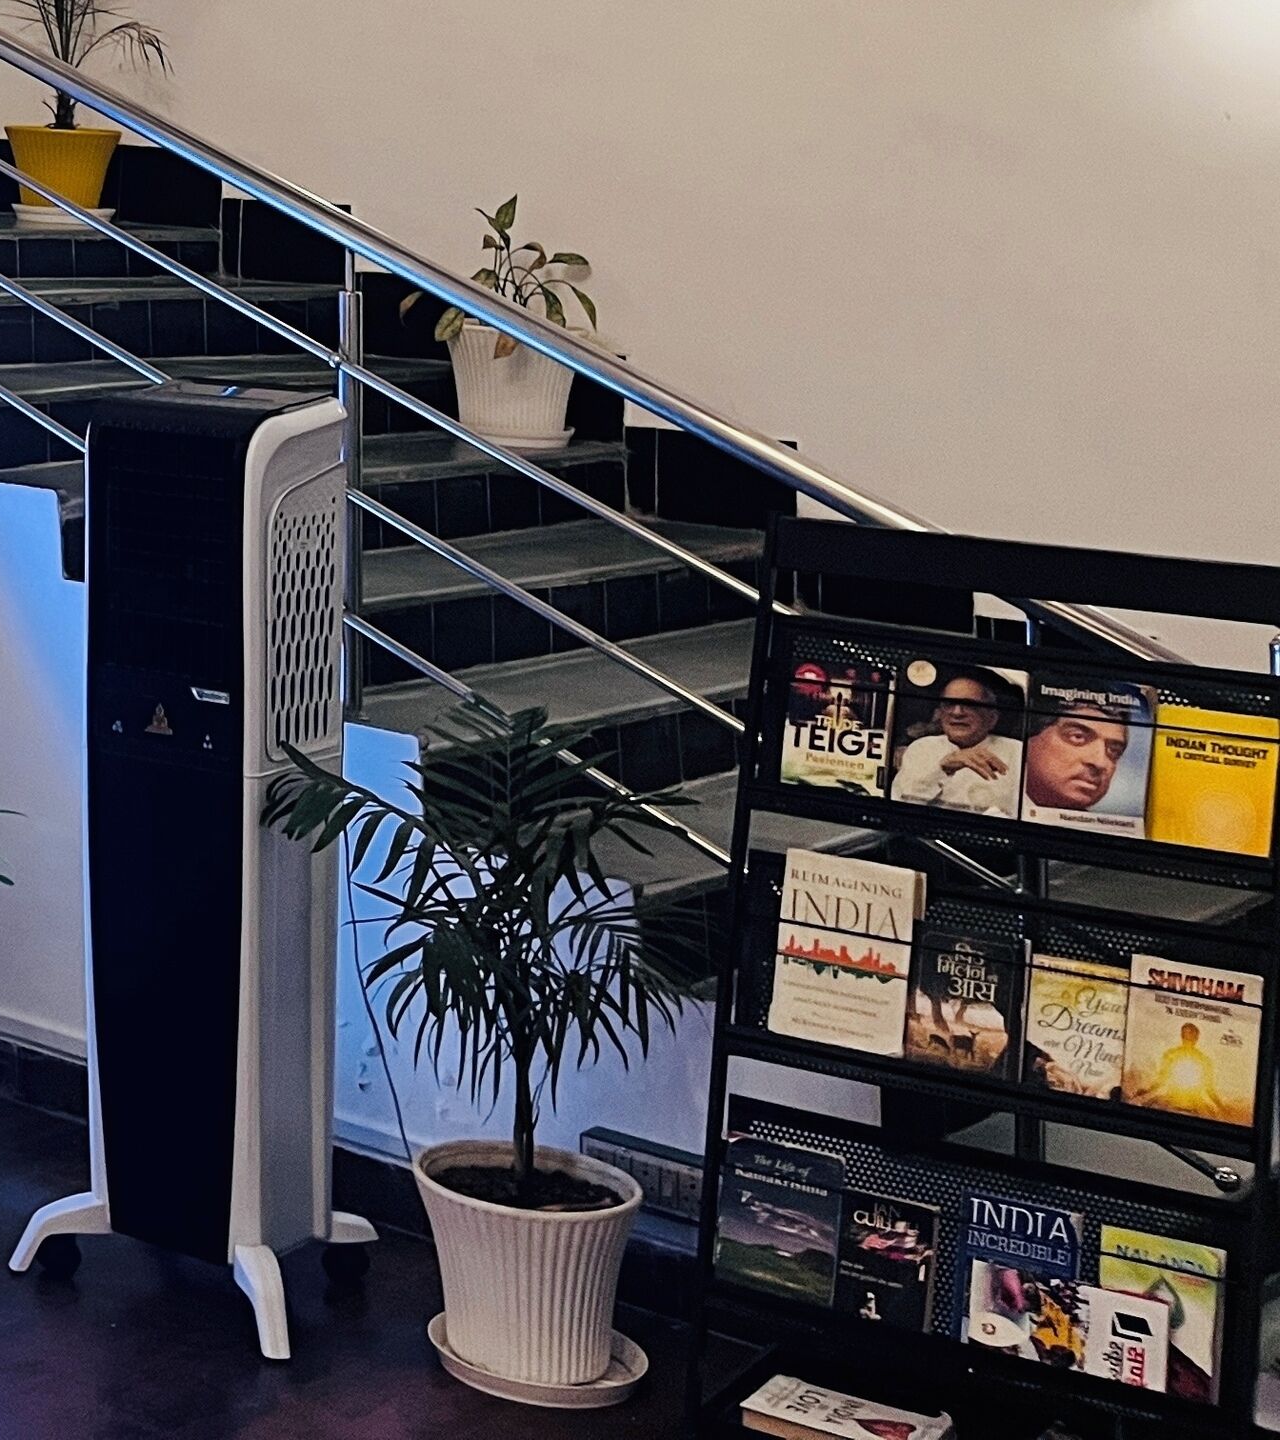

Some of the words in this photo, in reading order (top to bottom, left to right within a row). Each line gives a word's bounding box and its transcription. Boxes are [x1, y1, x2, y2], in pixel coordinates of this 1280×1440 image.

[1040, 684, 1106, 705] Imagining
[1109, 692, 1141, 706] India
[789, 721, 885, 760] TEIGE
[1166, 736, 1206, 751] INDIAN
[1210, 742, 1269, 760] THOUGHT
[1175, 751, 1181, 759] A
[790, 868, 903, 900] REIMAGINING
[790, 888, 900, 940] INDIA
[947, 976, 998, 1003] आस
[754, 1154, 773, 1167] The
[775, 1158, 795, 1173] Life
[798, 1166, 813, 1178] of
[970, 1197, 1069, 1244] INDIA
